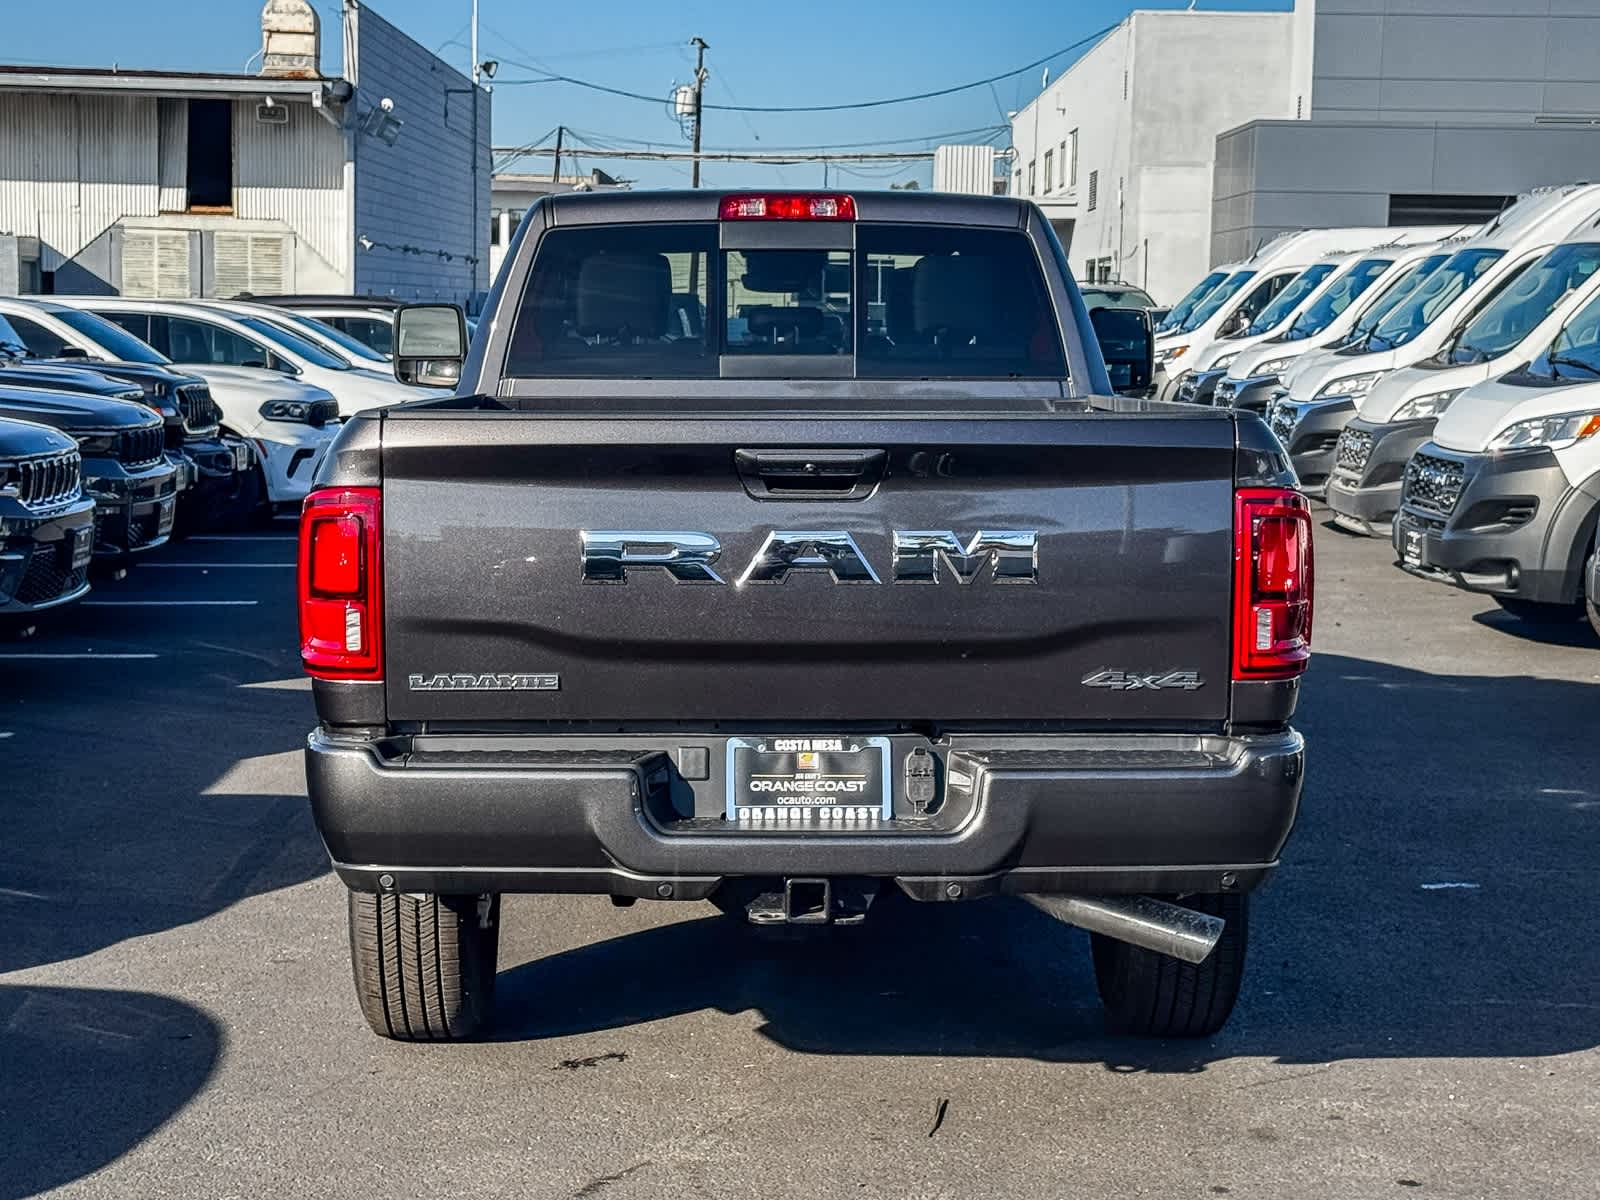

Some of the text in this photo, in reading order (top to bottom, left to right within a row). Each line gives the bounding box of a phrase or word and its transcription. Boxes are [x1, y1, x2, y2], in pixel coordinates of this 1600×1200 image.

[580, 530, 1040, 585] RAM
[408, 674, 560, 691] LARAMIE
[774, 739, 843, 751] COSTA MESA
[777, 795, 836, 805] ocauto.com
[819, 807, 880, 819] COAST
